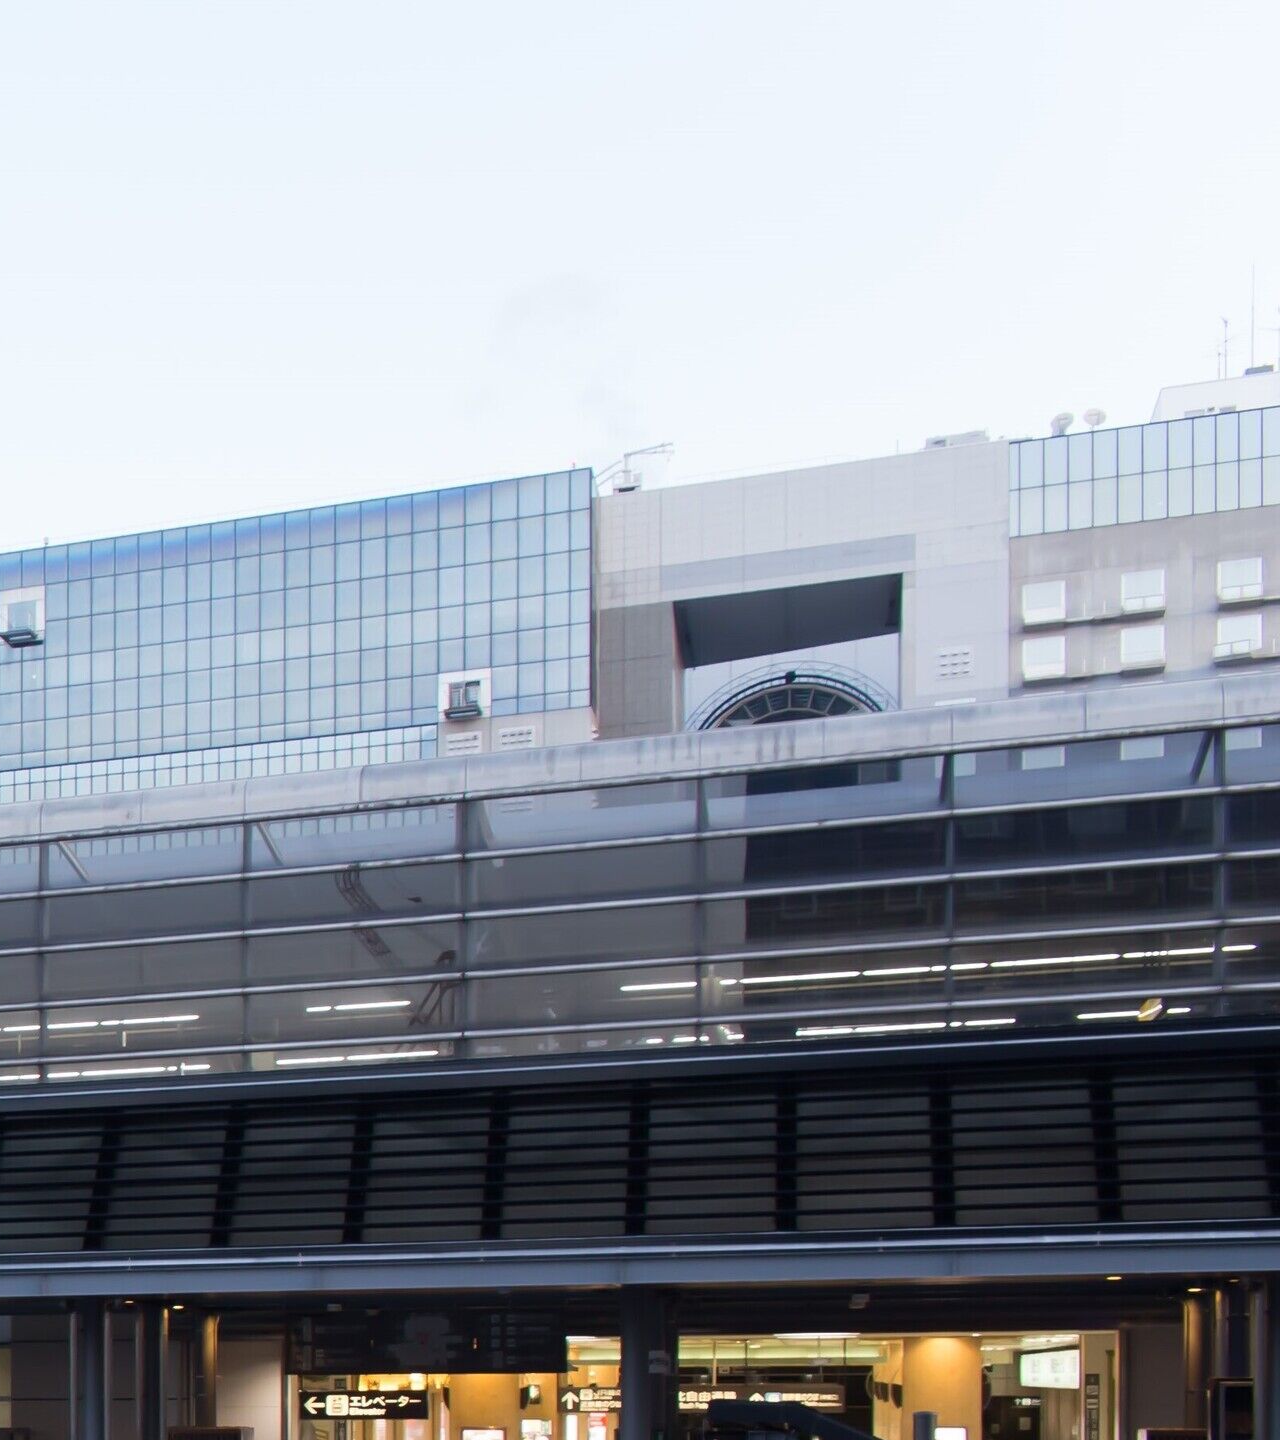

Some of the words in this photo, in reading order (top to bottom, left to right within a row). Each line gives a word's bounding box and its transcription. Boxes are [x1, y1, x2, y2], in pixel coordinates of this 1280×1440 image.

[349, 1395, 422, 1407] エレベーター
